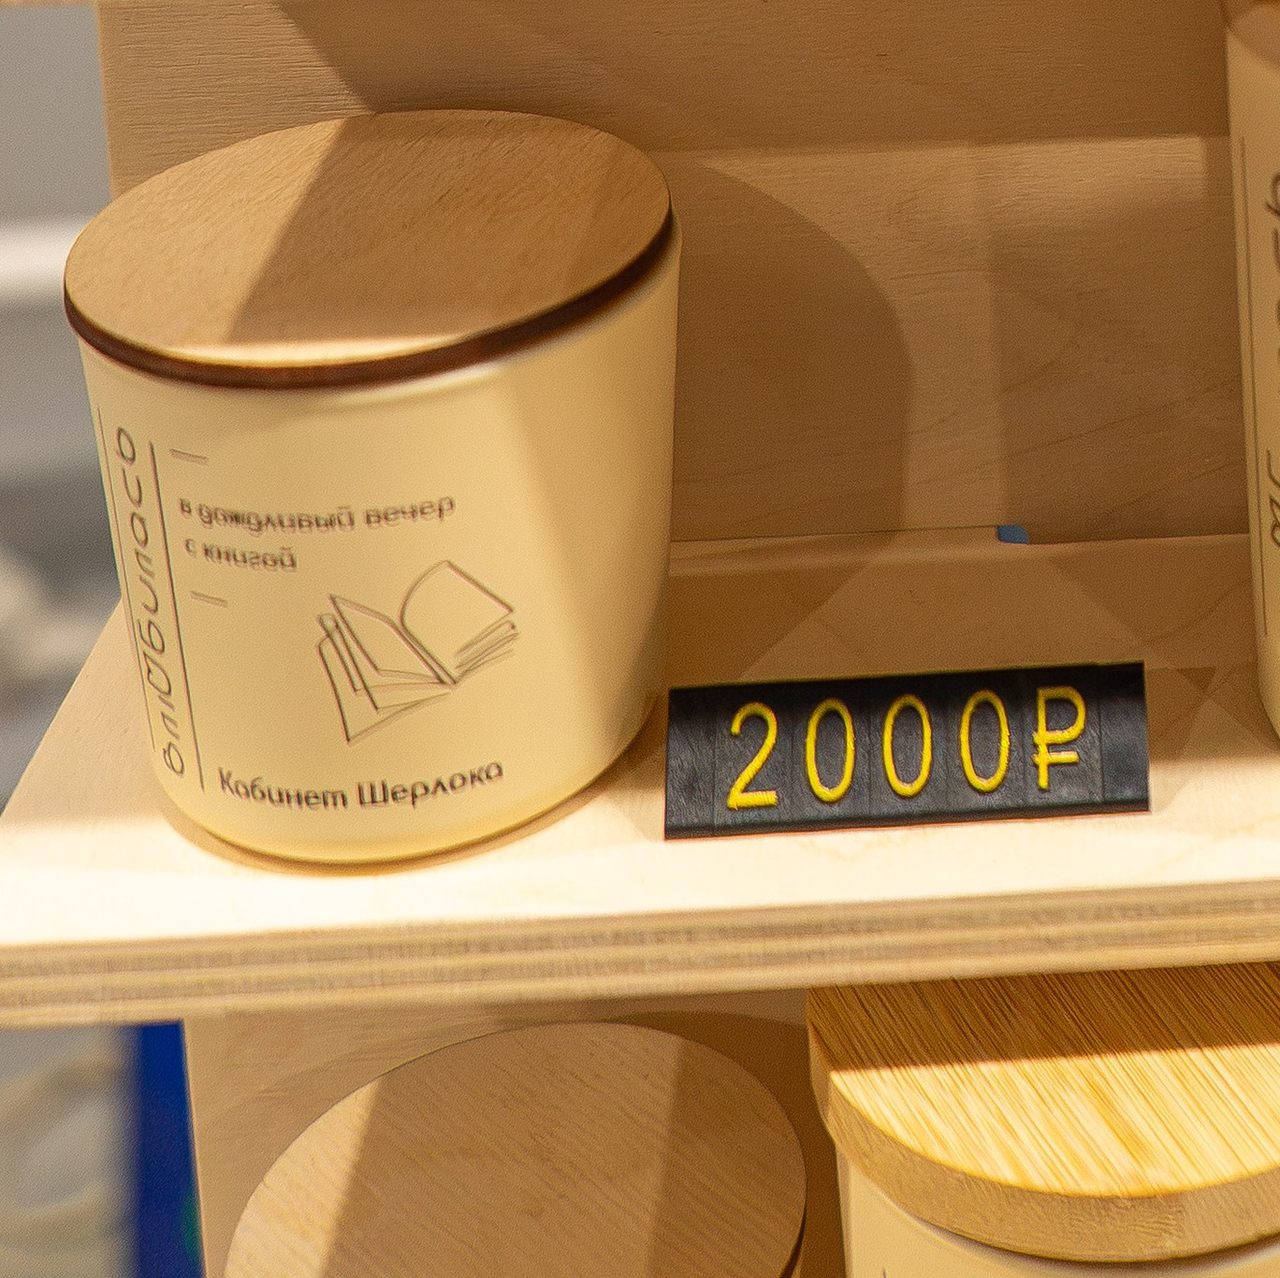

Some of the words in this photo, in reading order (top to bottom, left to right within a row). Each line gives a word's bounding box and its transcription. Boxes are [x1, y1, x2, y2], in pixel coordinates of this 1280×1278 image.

[198, 503, 355, 537] дождливый
[364, 496, 455, 528] вечер
[203, 545, 297, 572] книгой
[218, 766, 349, 811] Кабинет
[355, 761, 505, 811] Шерлока
